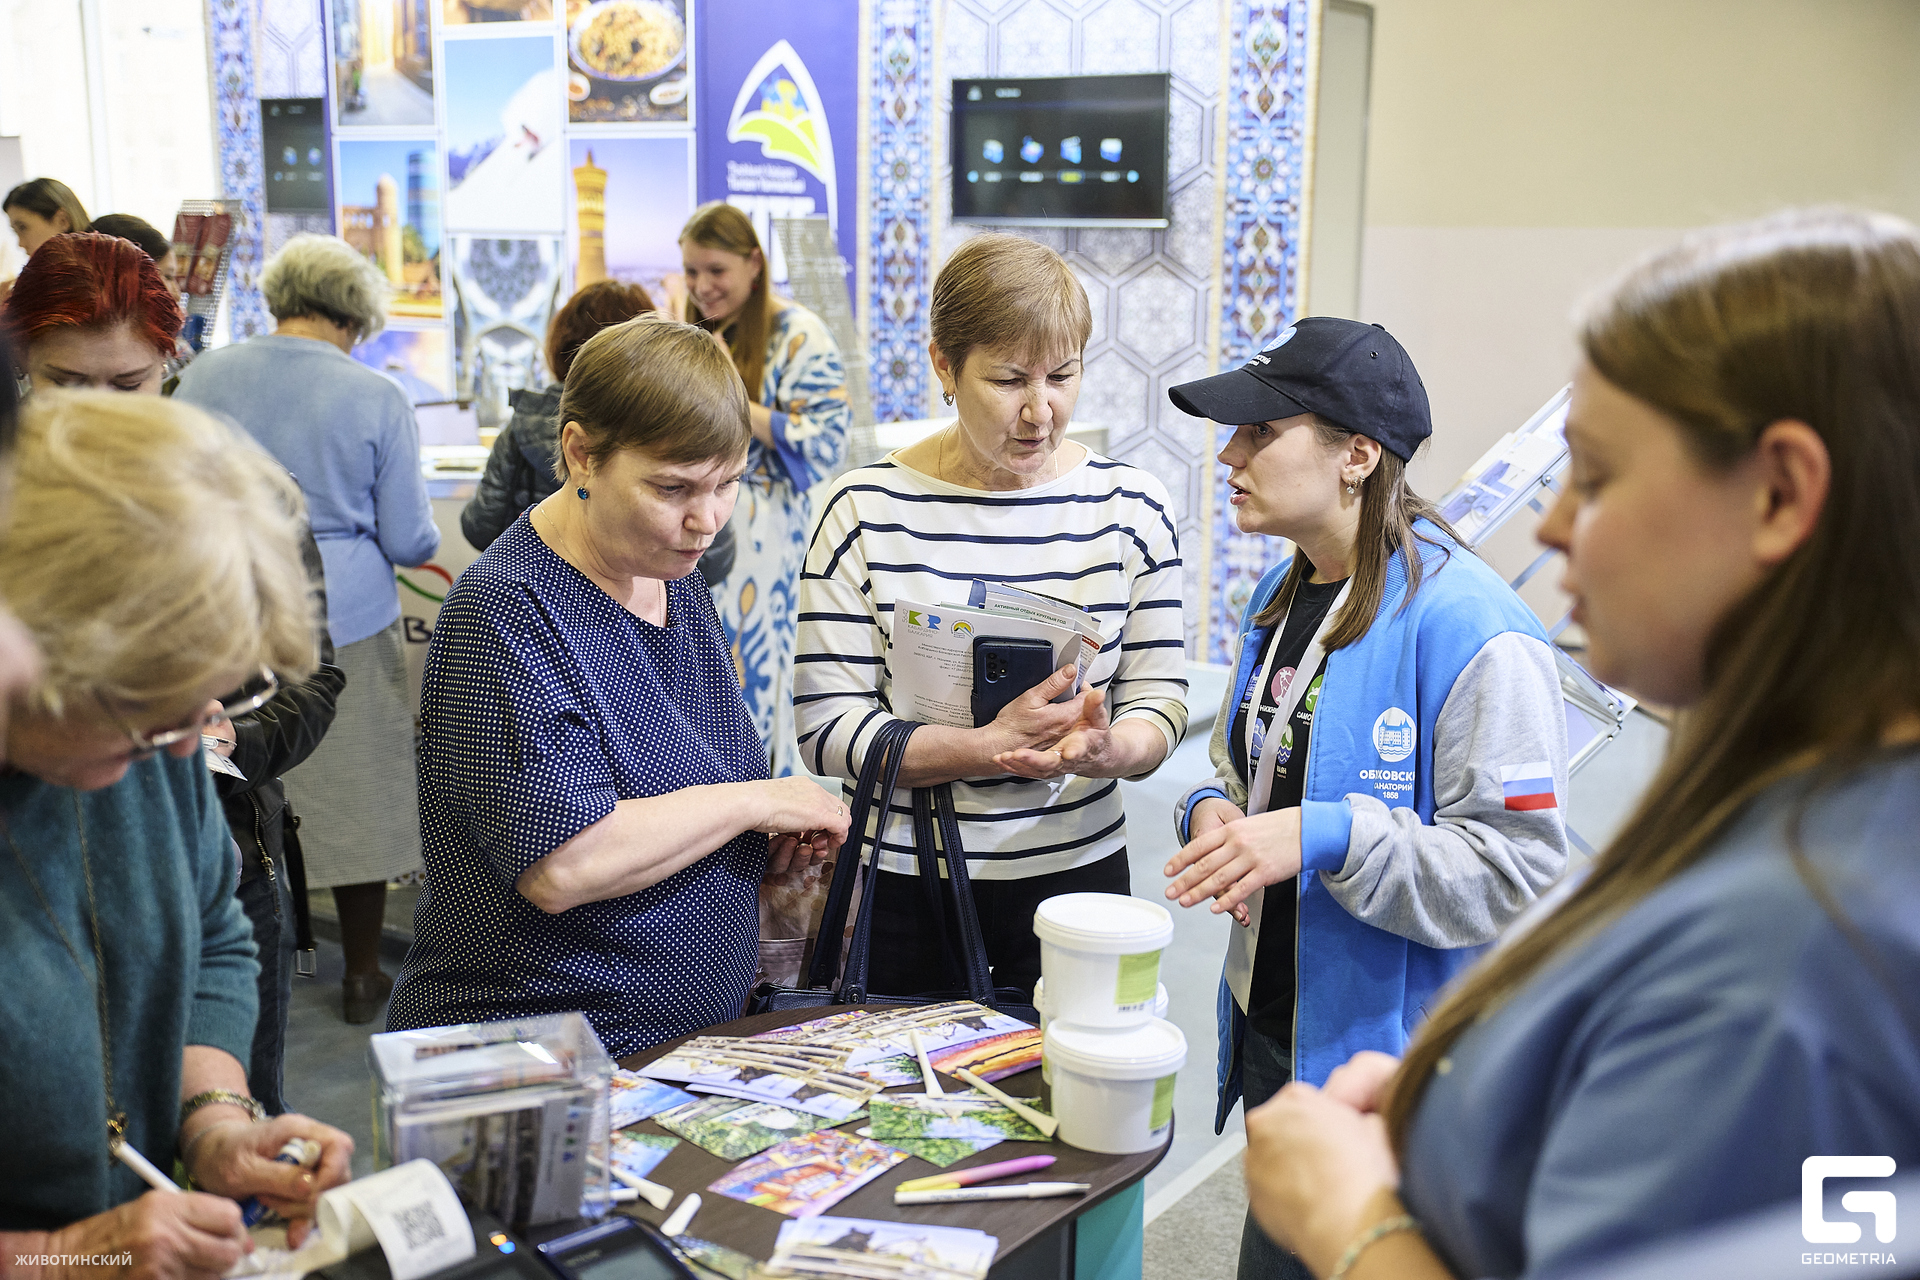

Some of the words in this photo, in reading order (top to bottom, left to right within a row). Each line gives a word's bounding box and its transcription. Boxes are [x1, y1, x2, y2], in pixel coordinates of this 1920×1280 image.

[994, 603, 1020, 612] АКТИВНЫЙ
[1020, 607, 1036, 616] ОТДЫХ
[1057, 617, 1067, 625] ГОД
[1382, 791, 1399, 799] 1858
